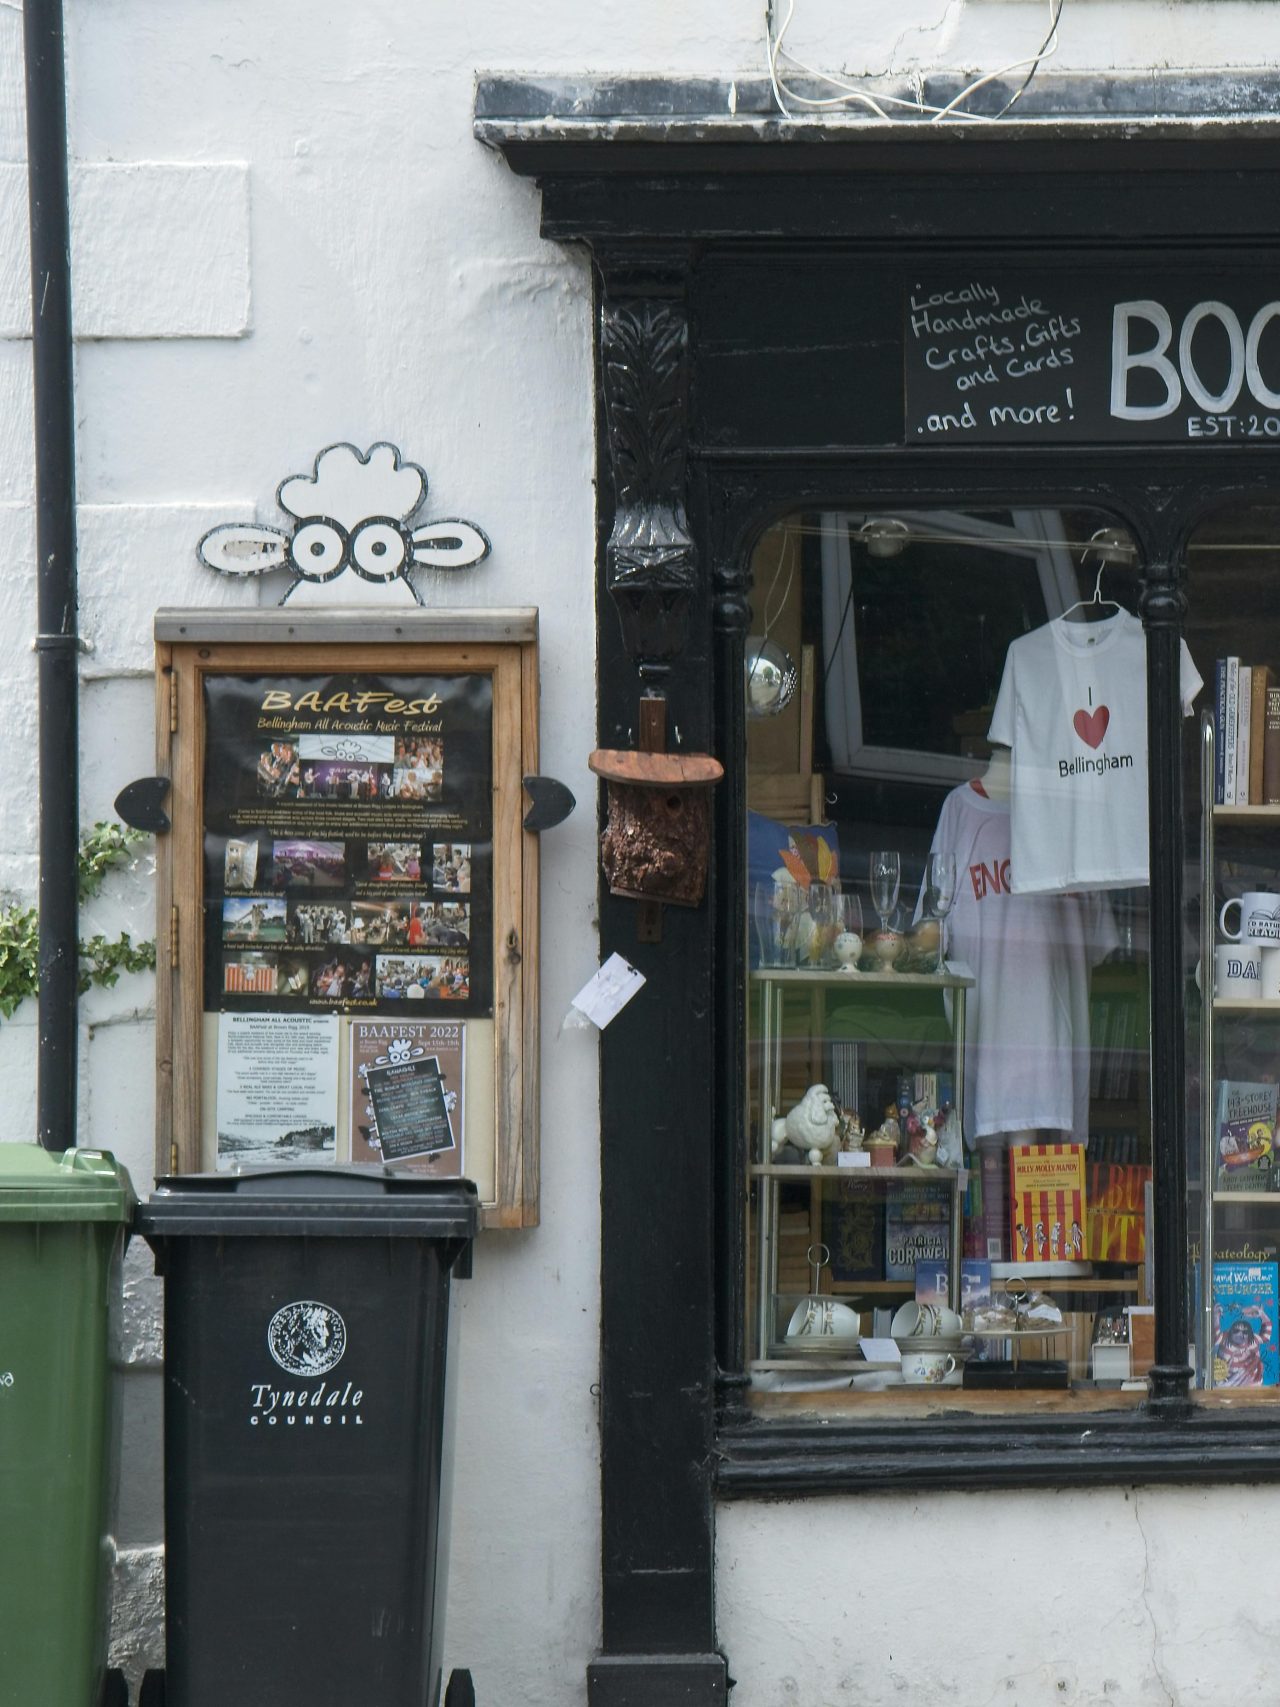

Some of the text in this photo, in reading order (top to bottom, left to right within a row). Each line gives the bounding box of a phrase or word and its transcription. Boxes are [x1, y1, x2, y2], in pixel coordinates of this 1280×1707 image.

[910, 283, 1002, 310] Locally
[911, 296, 1050, 338] Handmade
[957, 347, 1074, 391] and Cards
[927, 387, 1076, 433] and more!
[260, 690, 443, 715] BAAFest
[1088, 686, 1093, 706] I
[257, 717, 443, 733] Bellingham All Acoustic Music Festival
[1058, 752, 1133, 778] Bellingham
[359, 1025, 459, 1038] BAAFEST 2022
[903, 1235, 943, 1245] PATRICIA
[251, 1381, 363, 1415] Tynedale
[250, 1415, 363, 1426] COUNCIL
